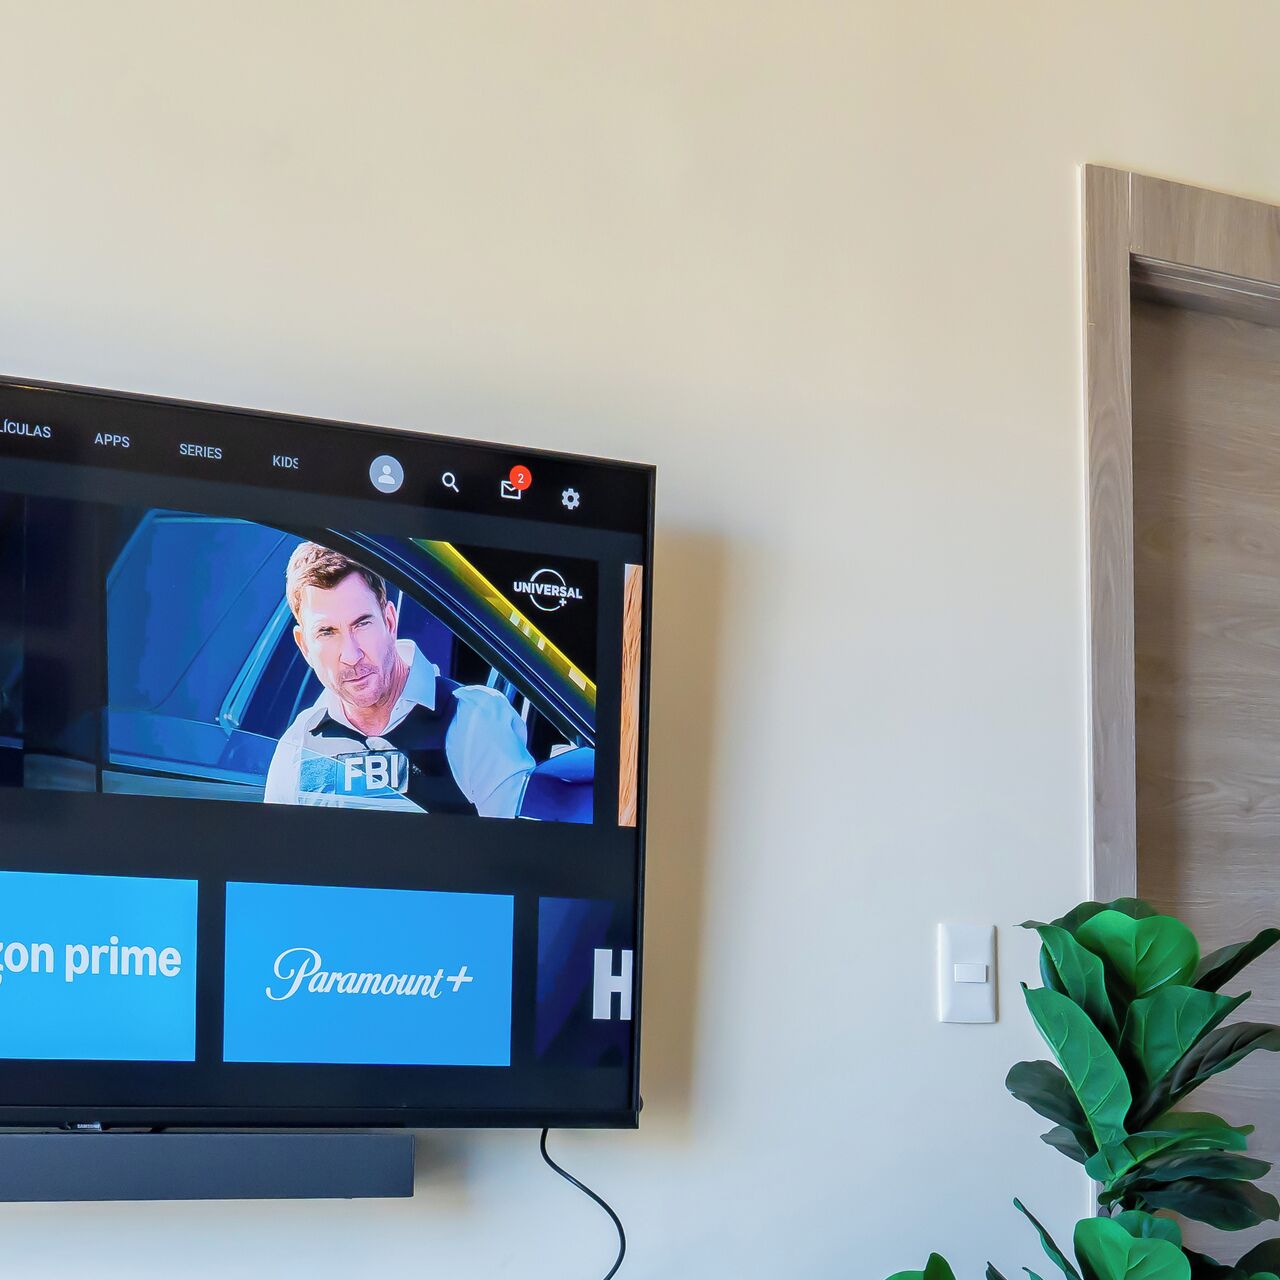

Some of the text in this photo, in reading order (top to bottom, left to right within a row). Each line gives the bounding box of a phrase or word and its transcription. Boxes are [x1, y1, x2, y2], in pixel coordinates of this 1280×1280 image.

[94, 432, 130, 448] APPS
[179, 443, 223, 460] SERIES
[517, 473, 525, 484] 2
[344, 754, 400, 792] FBI
[65, 935, 182, 983] prime
[265, 947, 474, 1001] Paramount+
